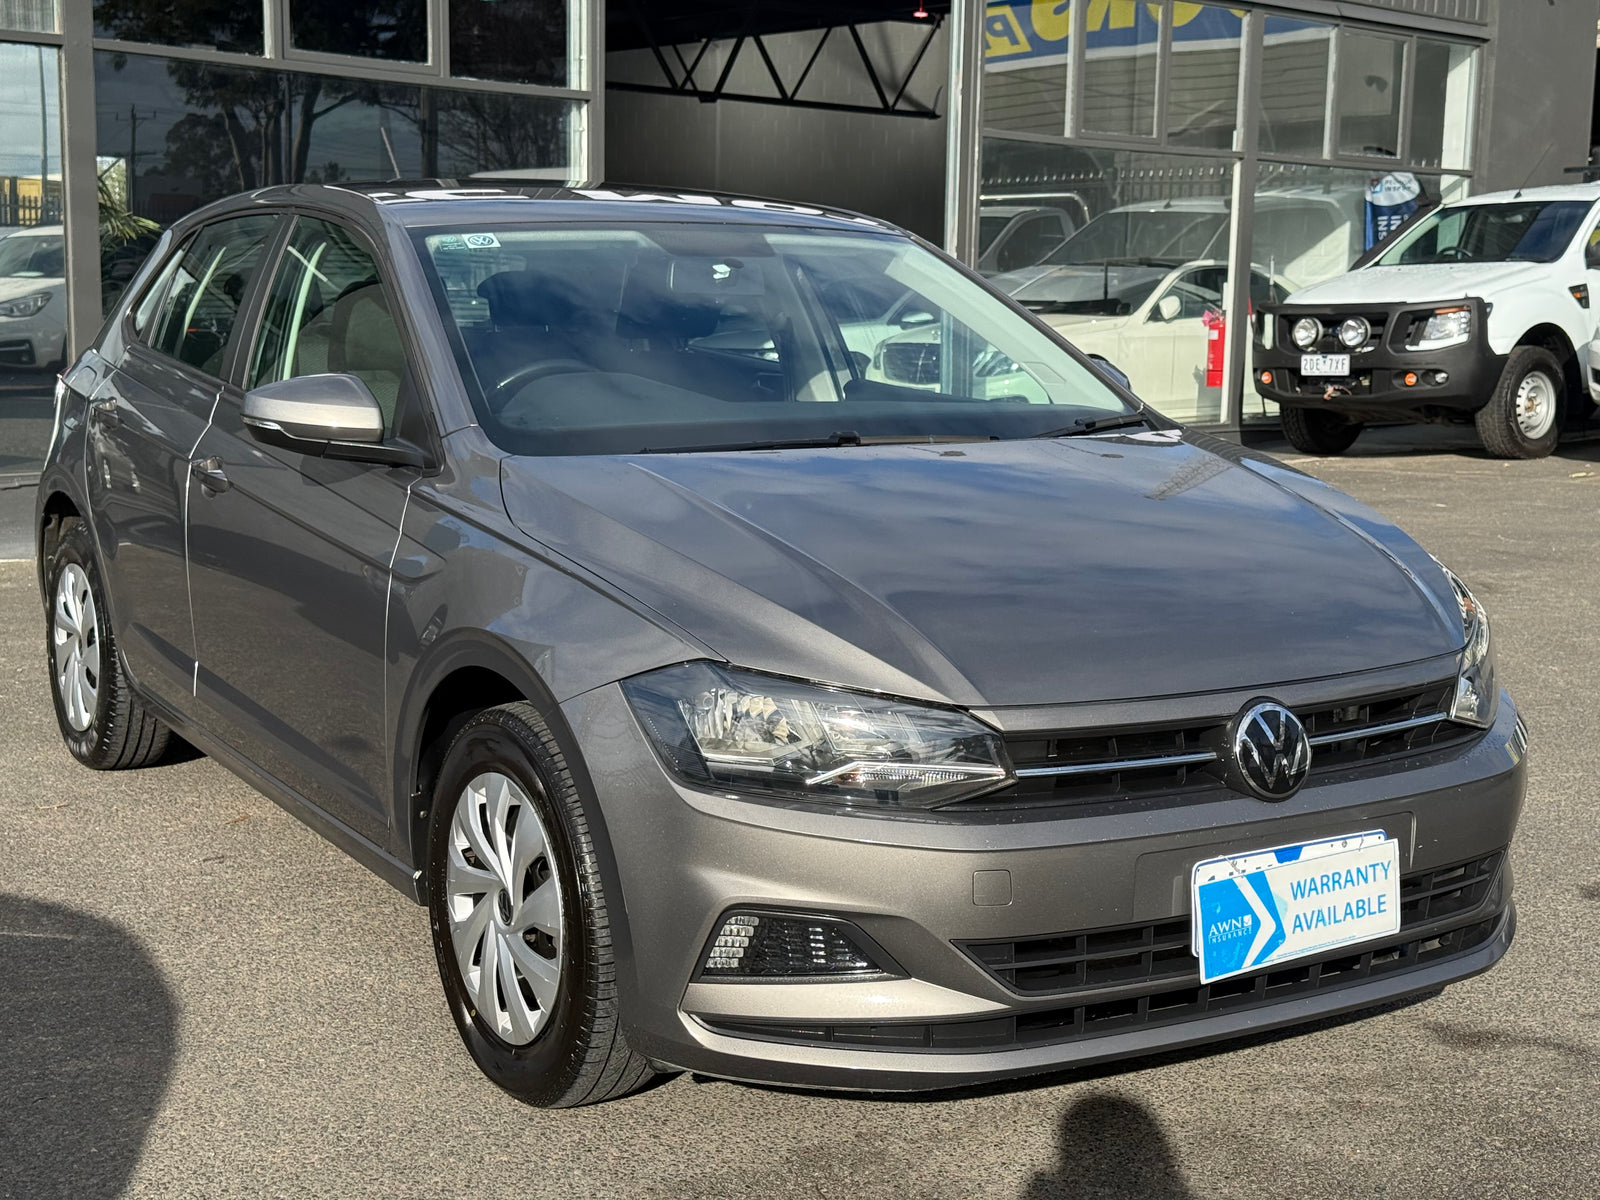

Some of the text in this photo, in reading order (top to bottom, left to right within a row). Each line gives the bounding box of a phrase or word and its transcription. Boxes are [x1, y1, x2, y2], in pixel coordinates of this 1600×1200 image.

[1290, 860, 1392, 901] WARRANTY
[1210, 916, 1242, 936] AWN
[1292, 894, 1387, 934] AVAILABLE
